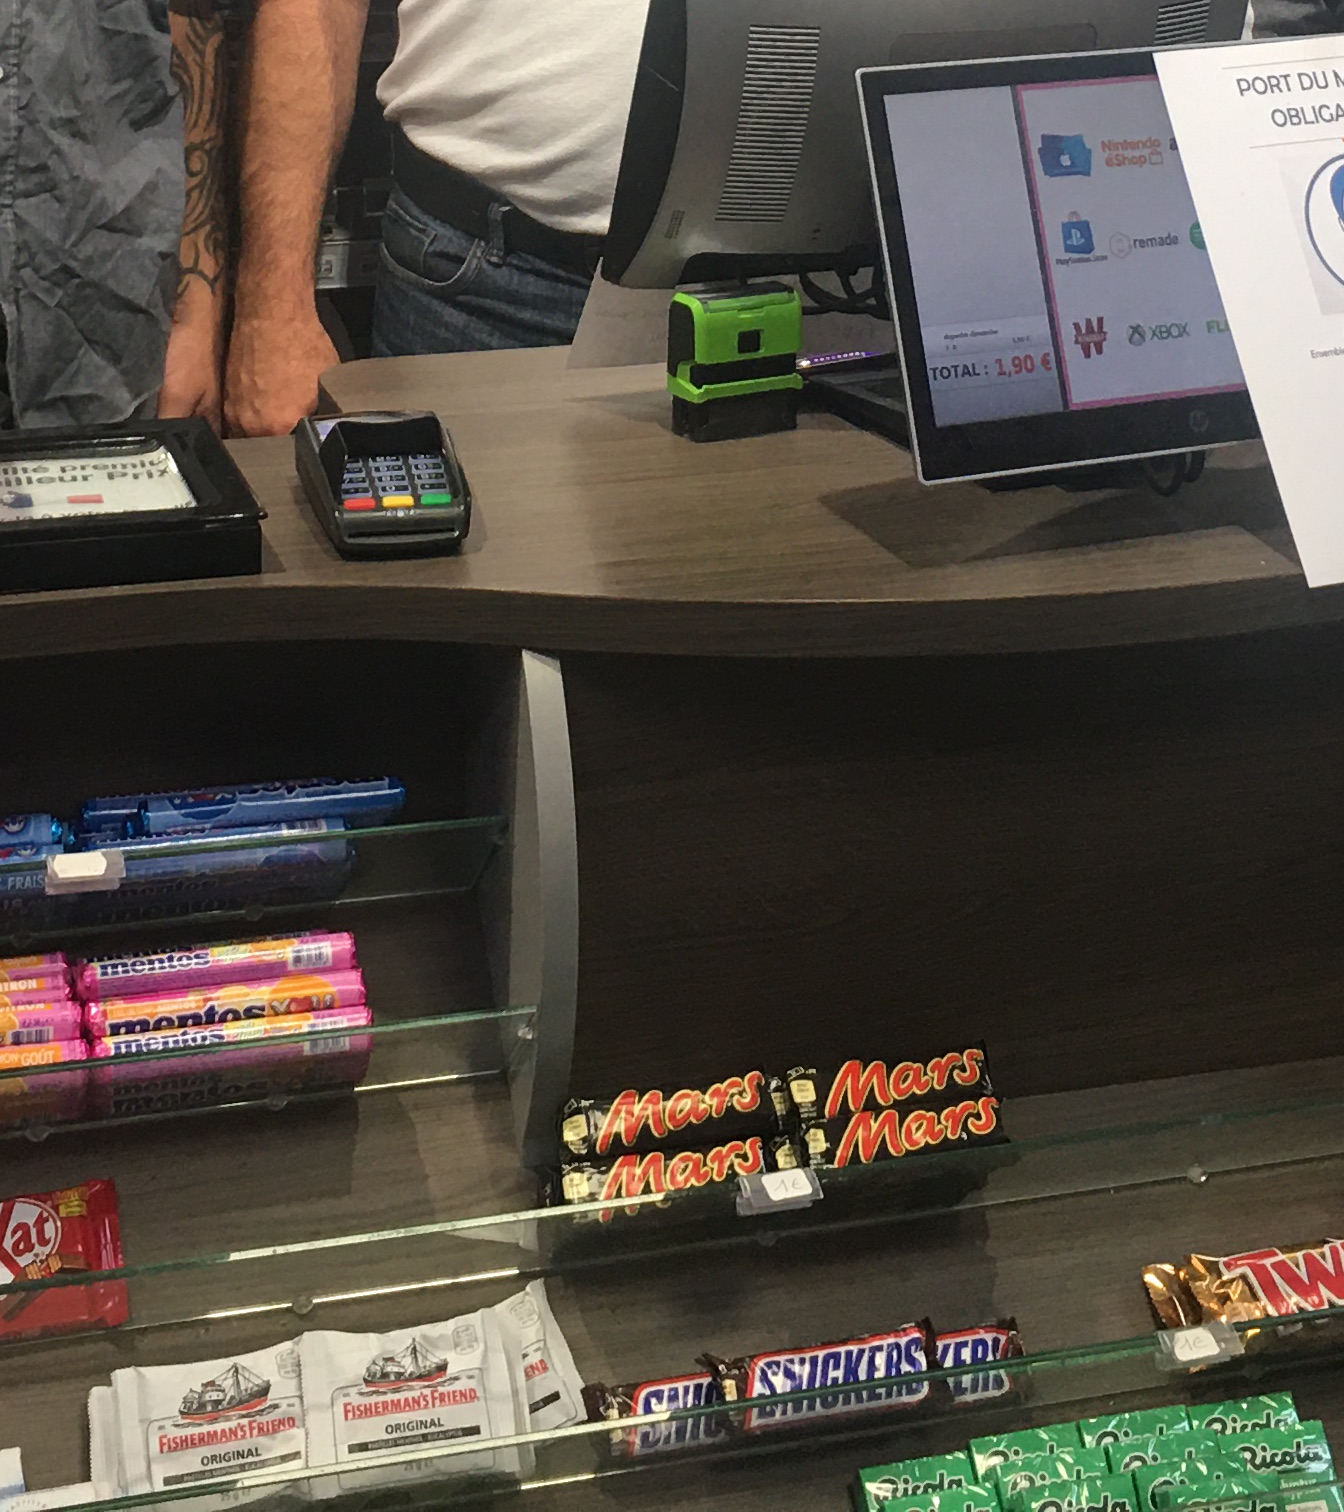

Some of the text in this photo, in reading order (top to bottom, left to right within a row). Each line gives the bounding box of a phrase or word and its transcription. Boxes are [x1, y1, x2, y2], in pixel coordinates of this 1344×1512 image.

[1236, 73, 1292, 97] PORT
[1299, 70, 1329, 92] DU
[1100, 136, 1162, 154] Nintendo
[1105, 152, 1147, 168] eShop
[1132, 232, 1180, 250] remade
[1148, 321, 1191, 341] XBOX
[98, 950, 211, 979] mentos
[108, 1002, 266, 1036] mentos
[824, 1047, 985, 1119] Mars
[595, 1070, 766, 1154] Mars
[835, 1095, 1001, 1169] Mars
[599, 1136, 765, 1224] Mars
[342, 1387, 479, 1422] FISHERMAN'S FRIEND
[157, 1416, 296, 1455] FISHERMAN'S FRIEND
[384, 1416, 445, 1436] ORIGINAL
[200, 1446, 262, 1468] ORIGINAL
[1237, 1440, 1325, 1470] Ricola
